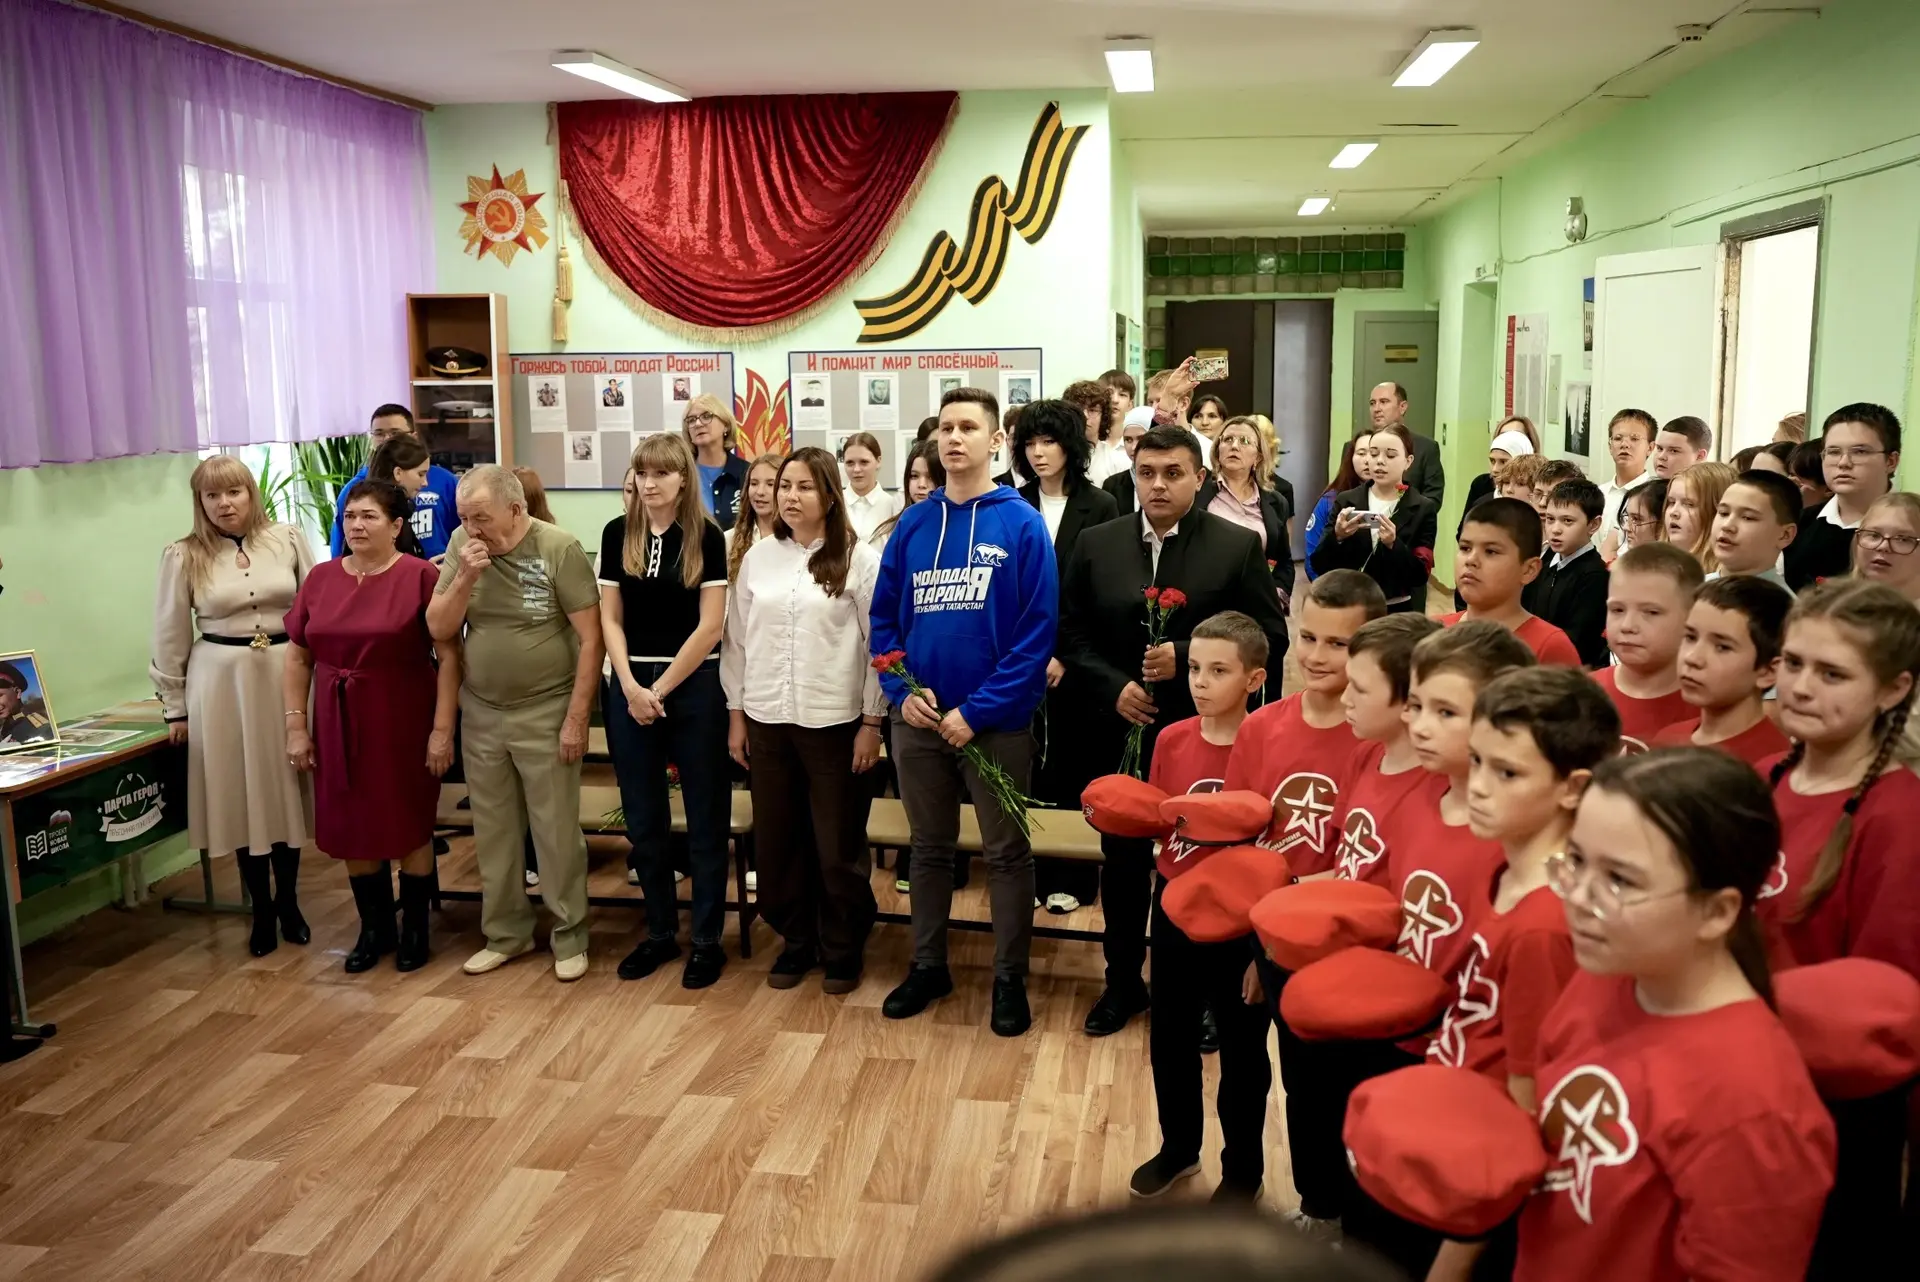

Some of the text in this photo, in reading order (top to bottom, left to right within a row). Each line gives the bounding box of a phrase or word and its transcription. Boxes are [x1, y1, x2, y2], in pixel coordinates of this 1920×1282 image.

[511, 357, 567, 375] ГОРЖУСЬ
[614, 359, 662, 374] СОЛДАТ
[807, 352, 817, 371] И
[822, 356, 876, 371] ПОМНИТ
[882, 355, 912, 370] МИР
[104, 782, 158, 814] ПАРТА ГЕРОЯ
